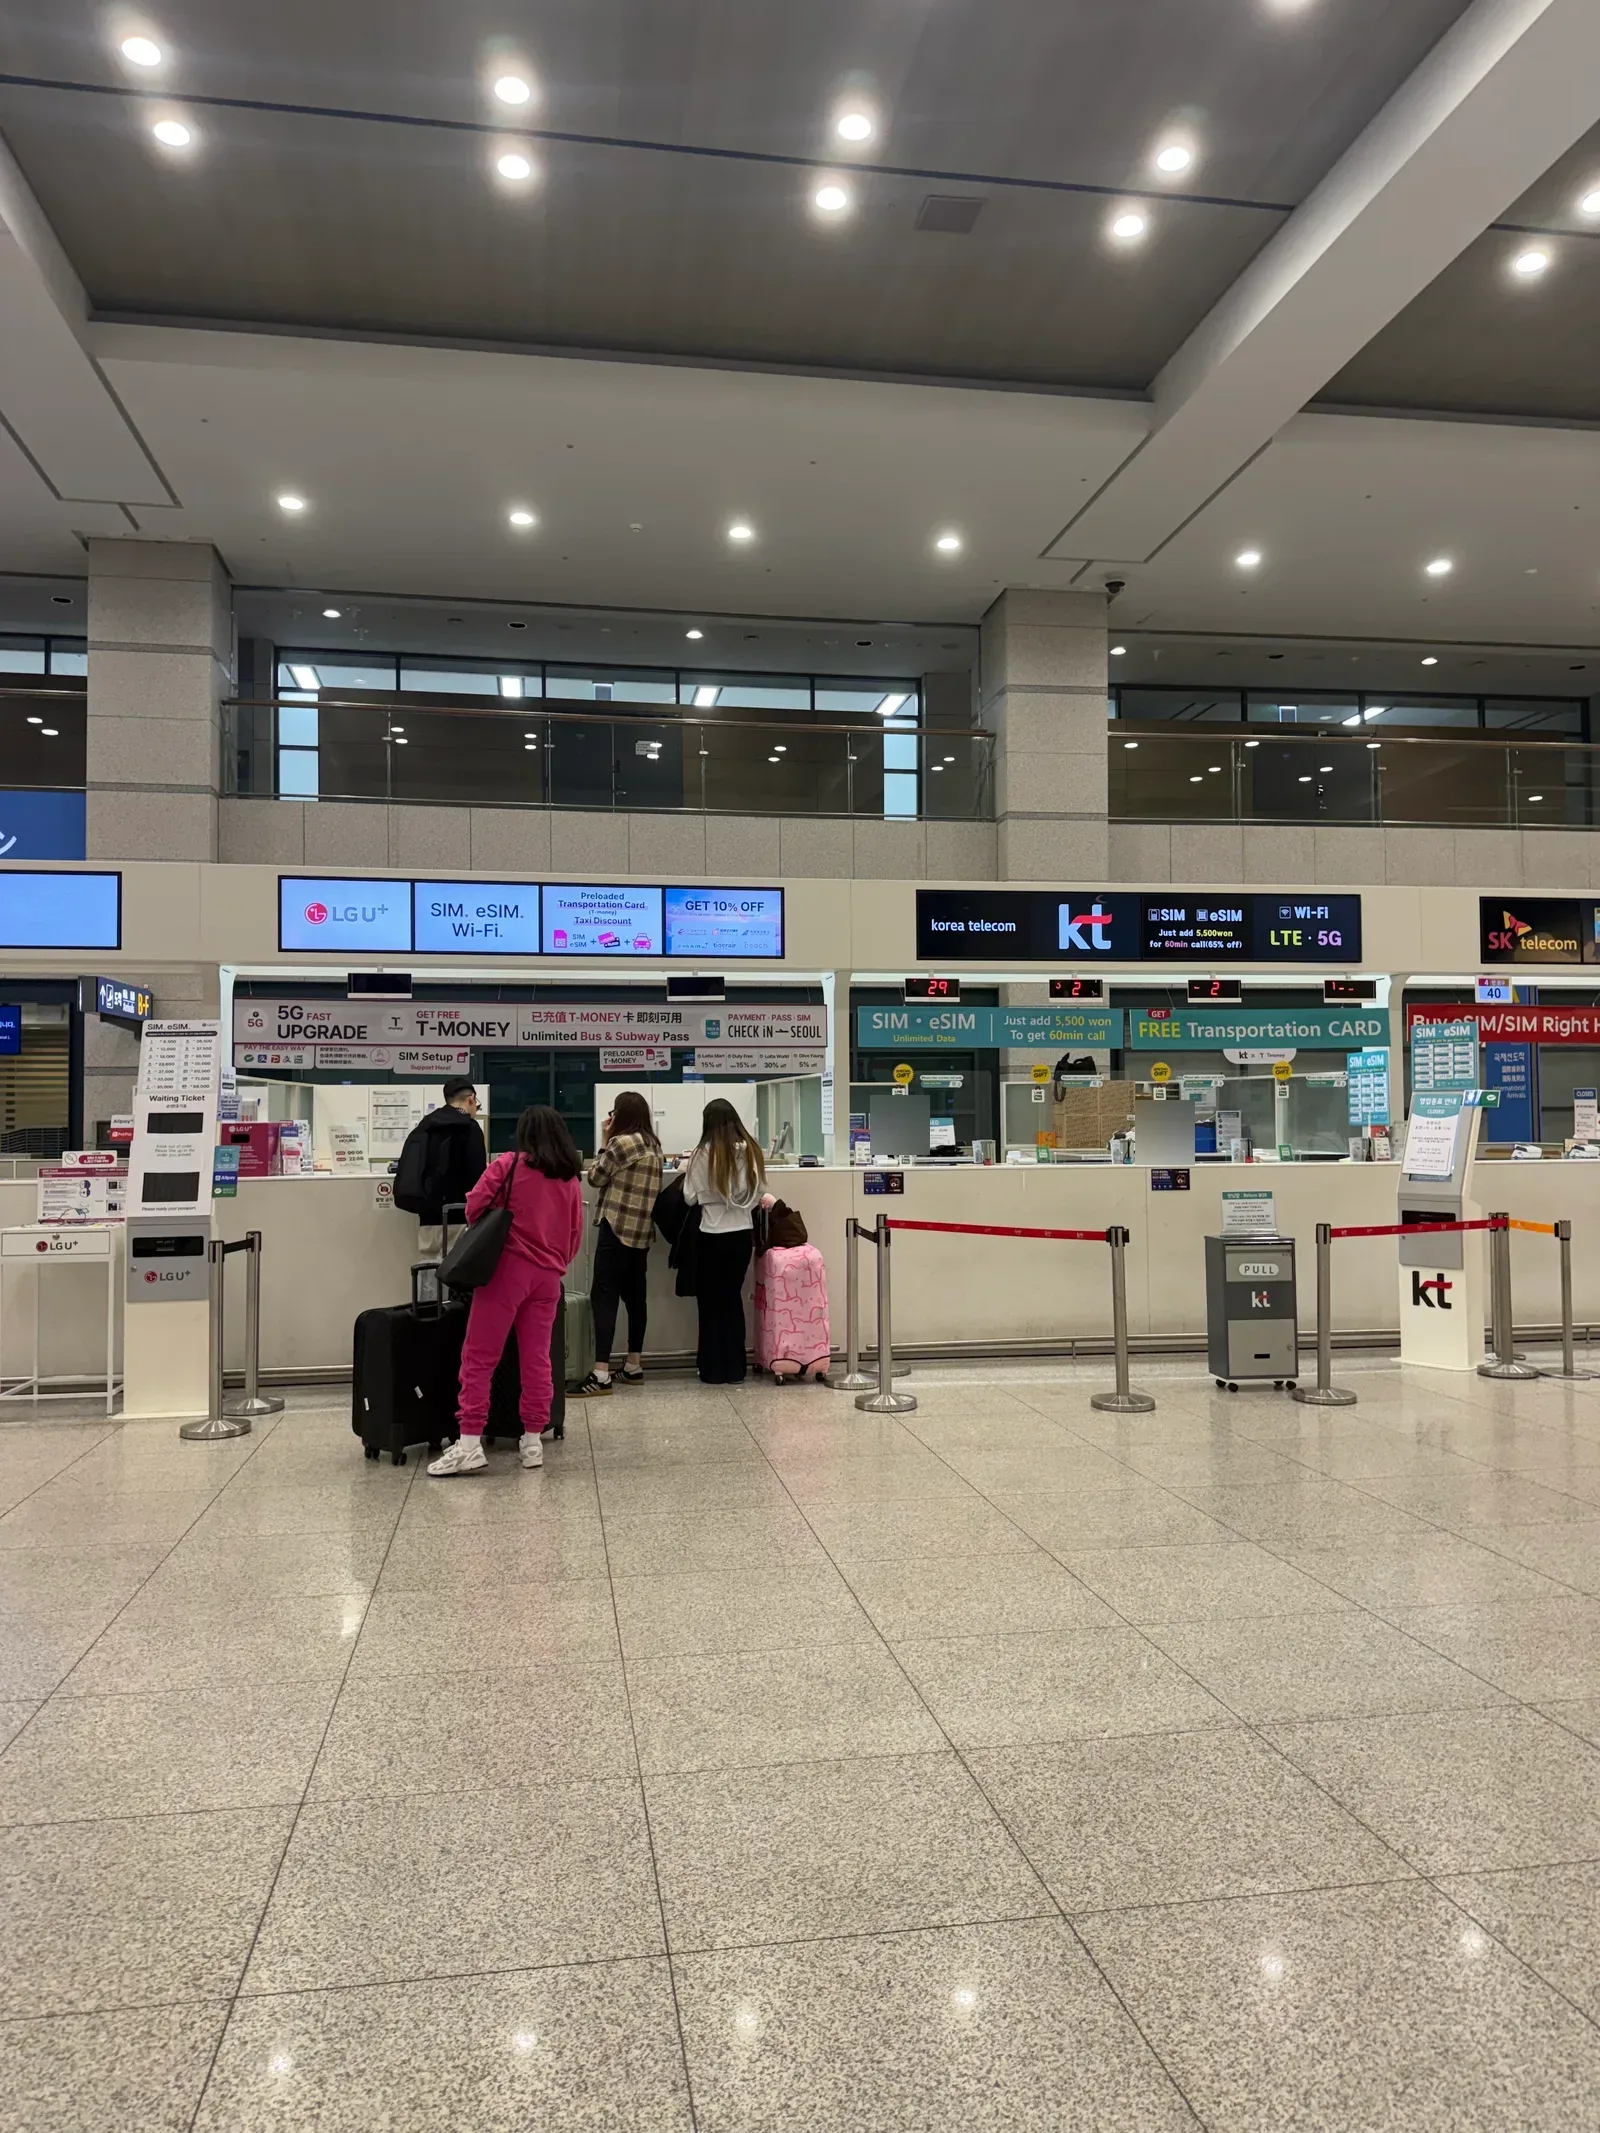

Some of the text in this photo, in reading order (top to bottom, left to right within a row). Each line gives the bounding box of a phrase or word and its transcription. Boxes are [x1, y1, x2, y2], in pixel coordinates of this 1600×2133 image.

[581, 892, 624, 900] Preloaded
[431, 903, 524, 919] SIM. eSIM.
[558, 901, 645, 909] Transportation Card
[685, 901, 764, 912] GET 10% OFF
[1160, 909, 1242, 922] SIM eSIM
[1294, 906, 1329, 919] Wi-Fi
[593, 917, 632, 925] Discount
[931, 919, 1016, 932] korea telecom
[1058, 904, 1112, 950] kt
[452, 923, 503, 938] Wi-Fi.
[1159, 929, 1233, 938] Just add 5,500won
[1149, 940, 1162, 949] for
[1165, 940, 1188, 949] 60min
[1271, 930, 1342, 947] LTE 5G
[1488, 931, 1577, 950] SK telecom
[928, 981, 948, 995] 29
[1071, 982, 1081, 996] 2
[1210, 982, 1220, 996] 2
[1487, 988, 1501, 998] 40
[278, 1005, 332, 1021] 5G FAST
[416, 1010, 460, 1019] GET FREE
[531, 1012, 682, 1024] 已充值 T-MONEY 卡 即刻可用
[247, 1018, 263, 1028] 5G
[872, 1013, 976, 1029] SIM eSIM
[1004, 1015, 1112, 1027] Just add 5,500 won
[1543, 1014, 1589, 1036] Right
[278, 1025, 367, 1040] UPGRADE
[416, 1021, 510, 1037] T-MONEY
[728, 1025, 759, 1038] CHECK
[791, 1026, 821, 1038] SEOUL
[1139, 1021, 1382, 1041] FREE Transportation CARD
[1416, 1026, 1470, 1038] SIM eSIM
[522, 1031, 689, 1044] Unlimited Bus & Subway Pass
[893, 1035, 956, 1043] Unlimited Data
[1010, 1030, 1105, 1043] To get 60min call
[399, 1052, 453, 1062] SIM Setup
[1239, 1051, 1248, 1059] kt
[1350, 1055, 1384, 1067] SIM eSIM
[1494, 1052, 1525, 1062] 국제선도착
[50, 1242, 64, 1251] LG
[1244, 1265, 1274, 1274] PULL
[160, 1272, 174, 1281] LG
[1412, 1270, 1452, 1309] kt
[1251, 1291, 1270, 1308] kt
